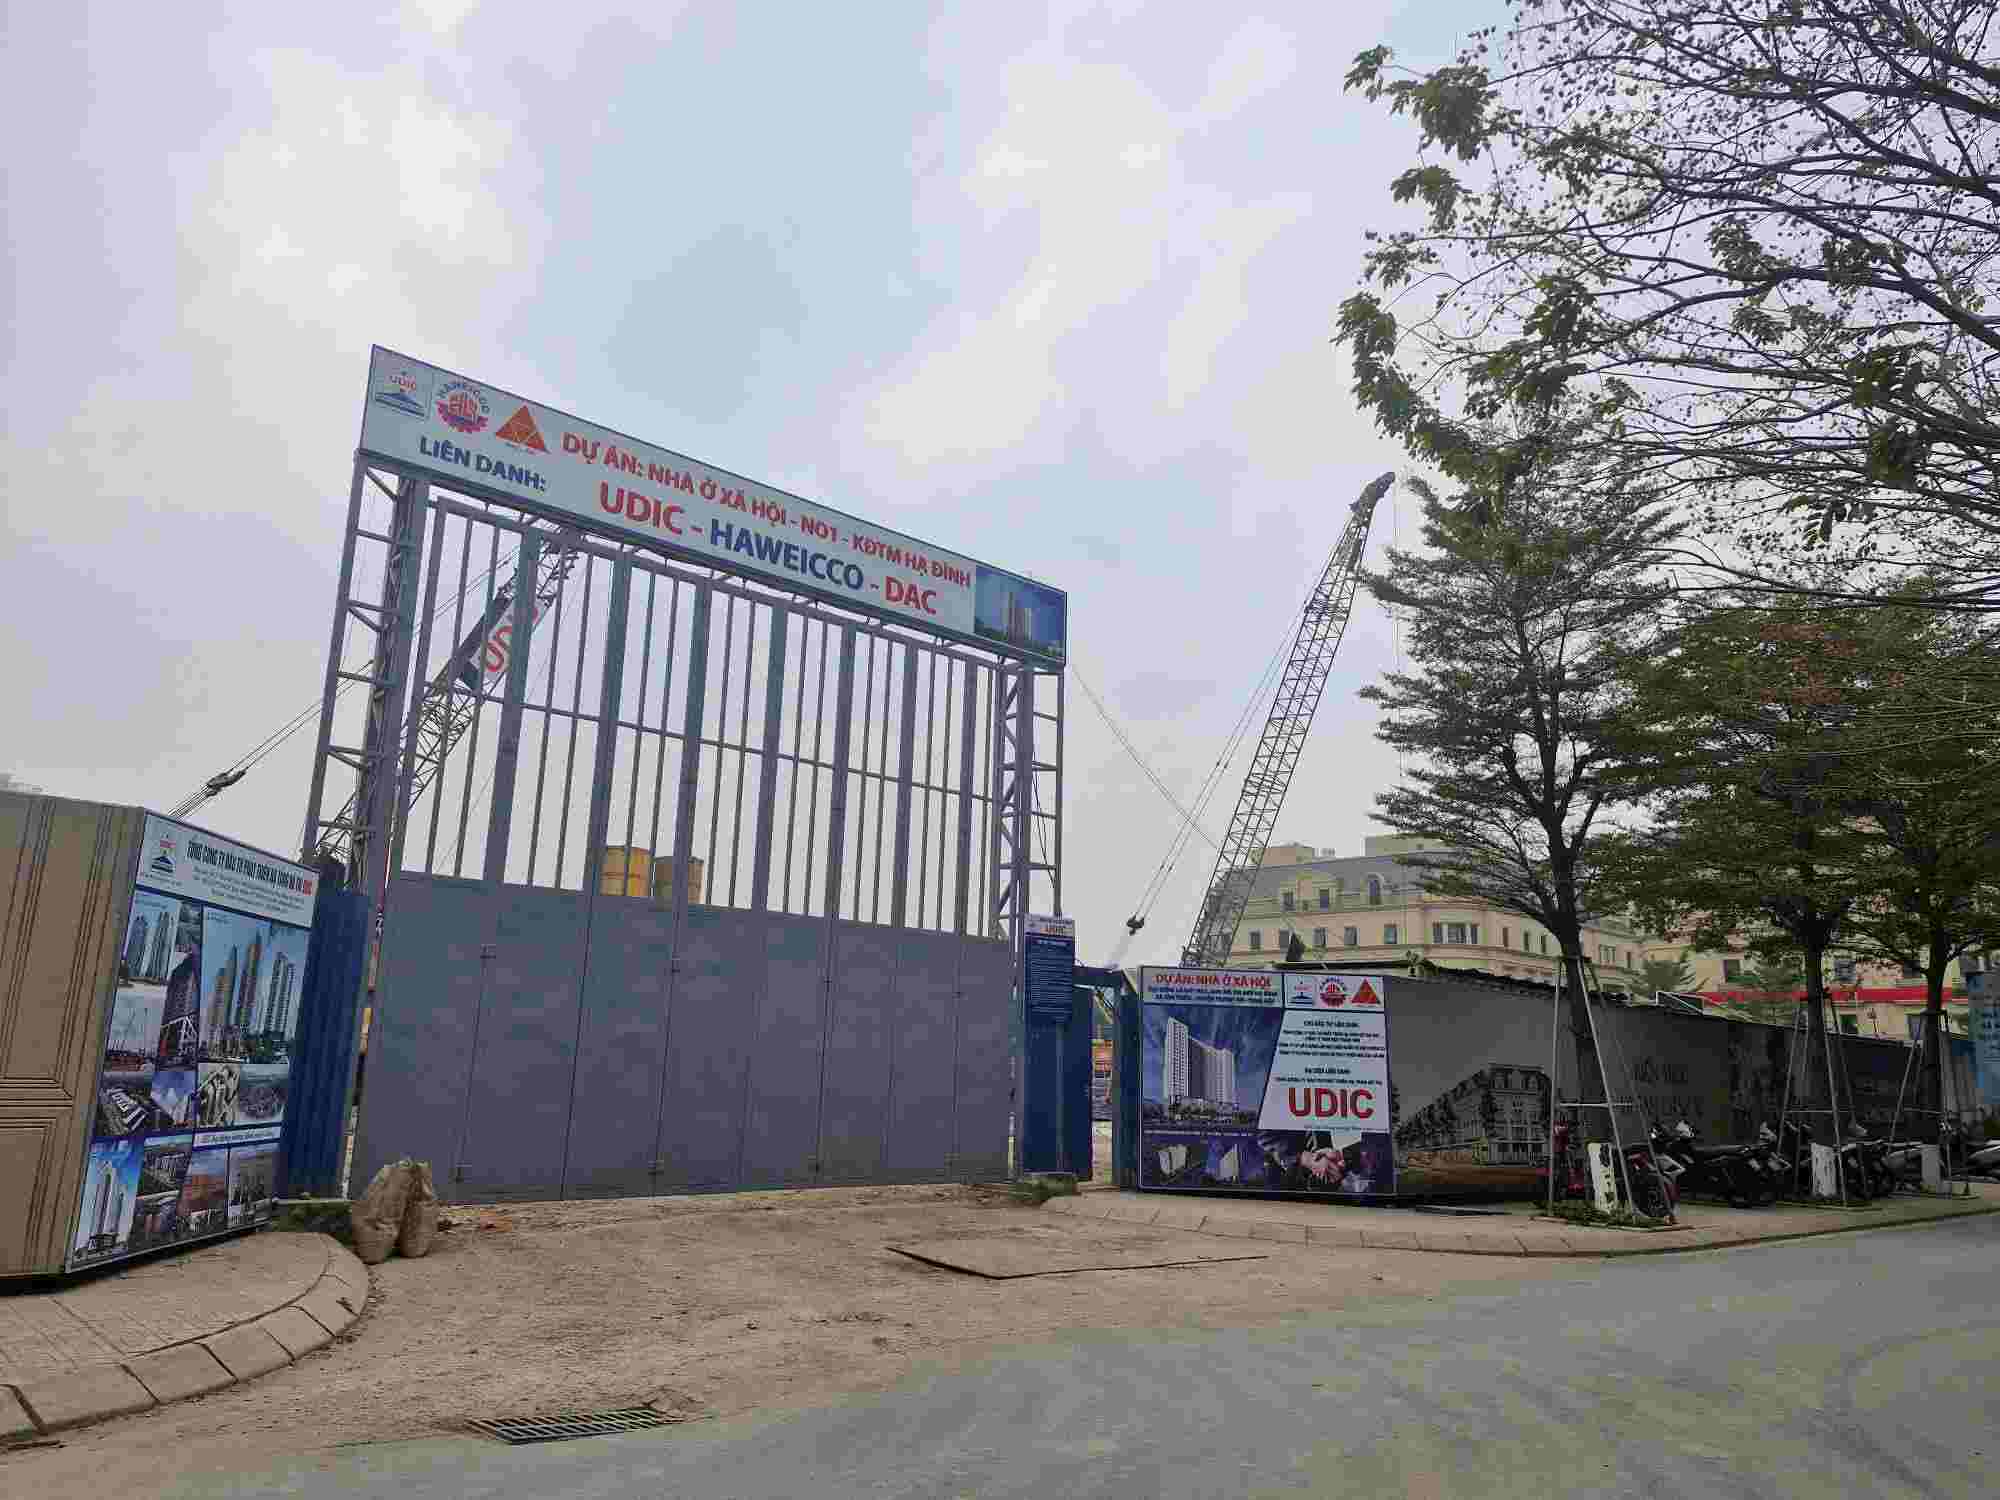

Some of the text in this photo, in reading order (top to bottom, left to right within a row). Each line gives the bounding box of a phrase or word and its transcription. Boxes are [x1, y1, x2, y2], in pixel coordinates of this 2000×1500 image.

[419, 434, 470, 467] LIÊN
[475, 453, 546, 492] DANH:
[562, 432, 600, 464] DỰ
[603, 442, 643, 477] ÁN:
[648, 463, 695, 495] NHÀ
[699, 477, 719, 501] Ở
[751, 499, 785, 528] HỘI
[852, 532, 901, 564] KĐTM
[905, 552, 928, 577] HẠ
[928, 558, 971, 589] ĐÌNH
[600, 481, 684, 536] UDIC
[710, 518, 864, 590] HAWEICCO
[885, 576, 937, 615] DAC
[1288, 1087, 1375, 1119] UDIC
